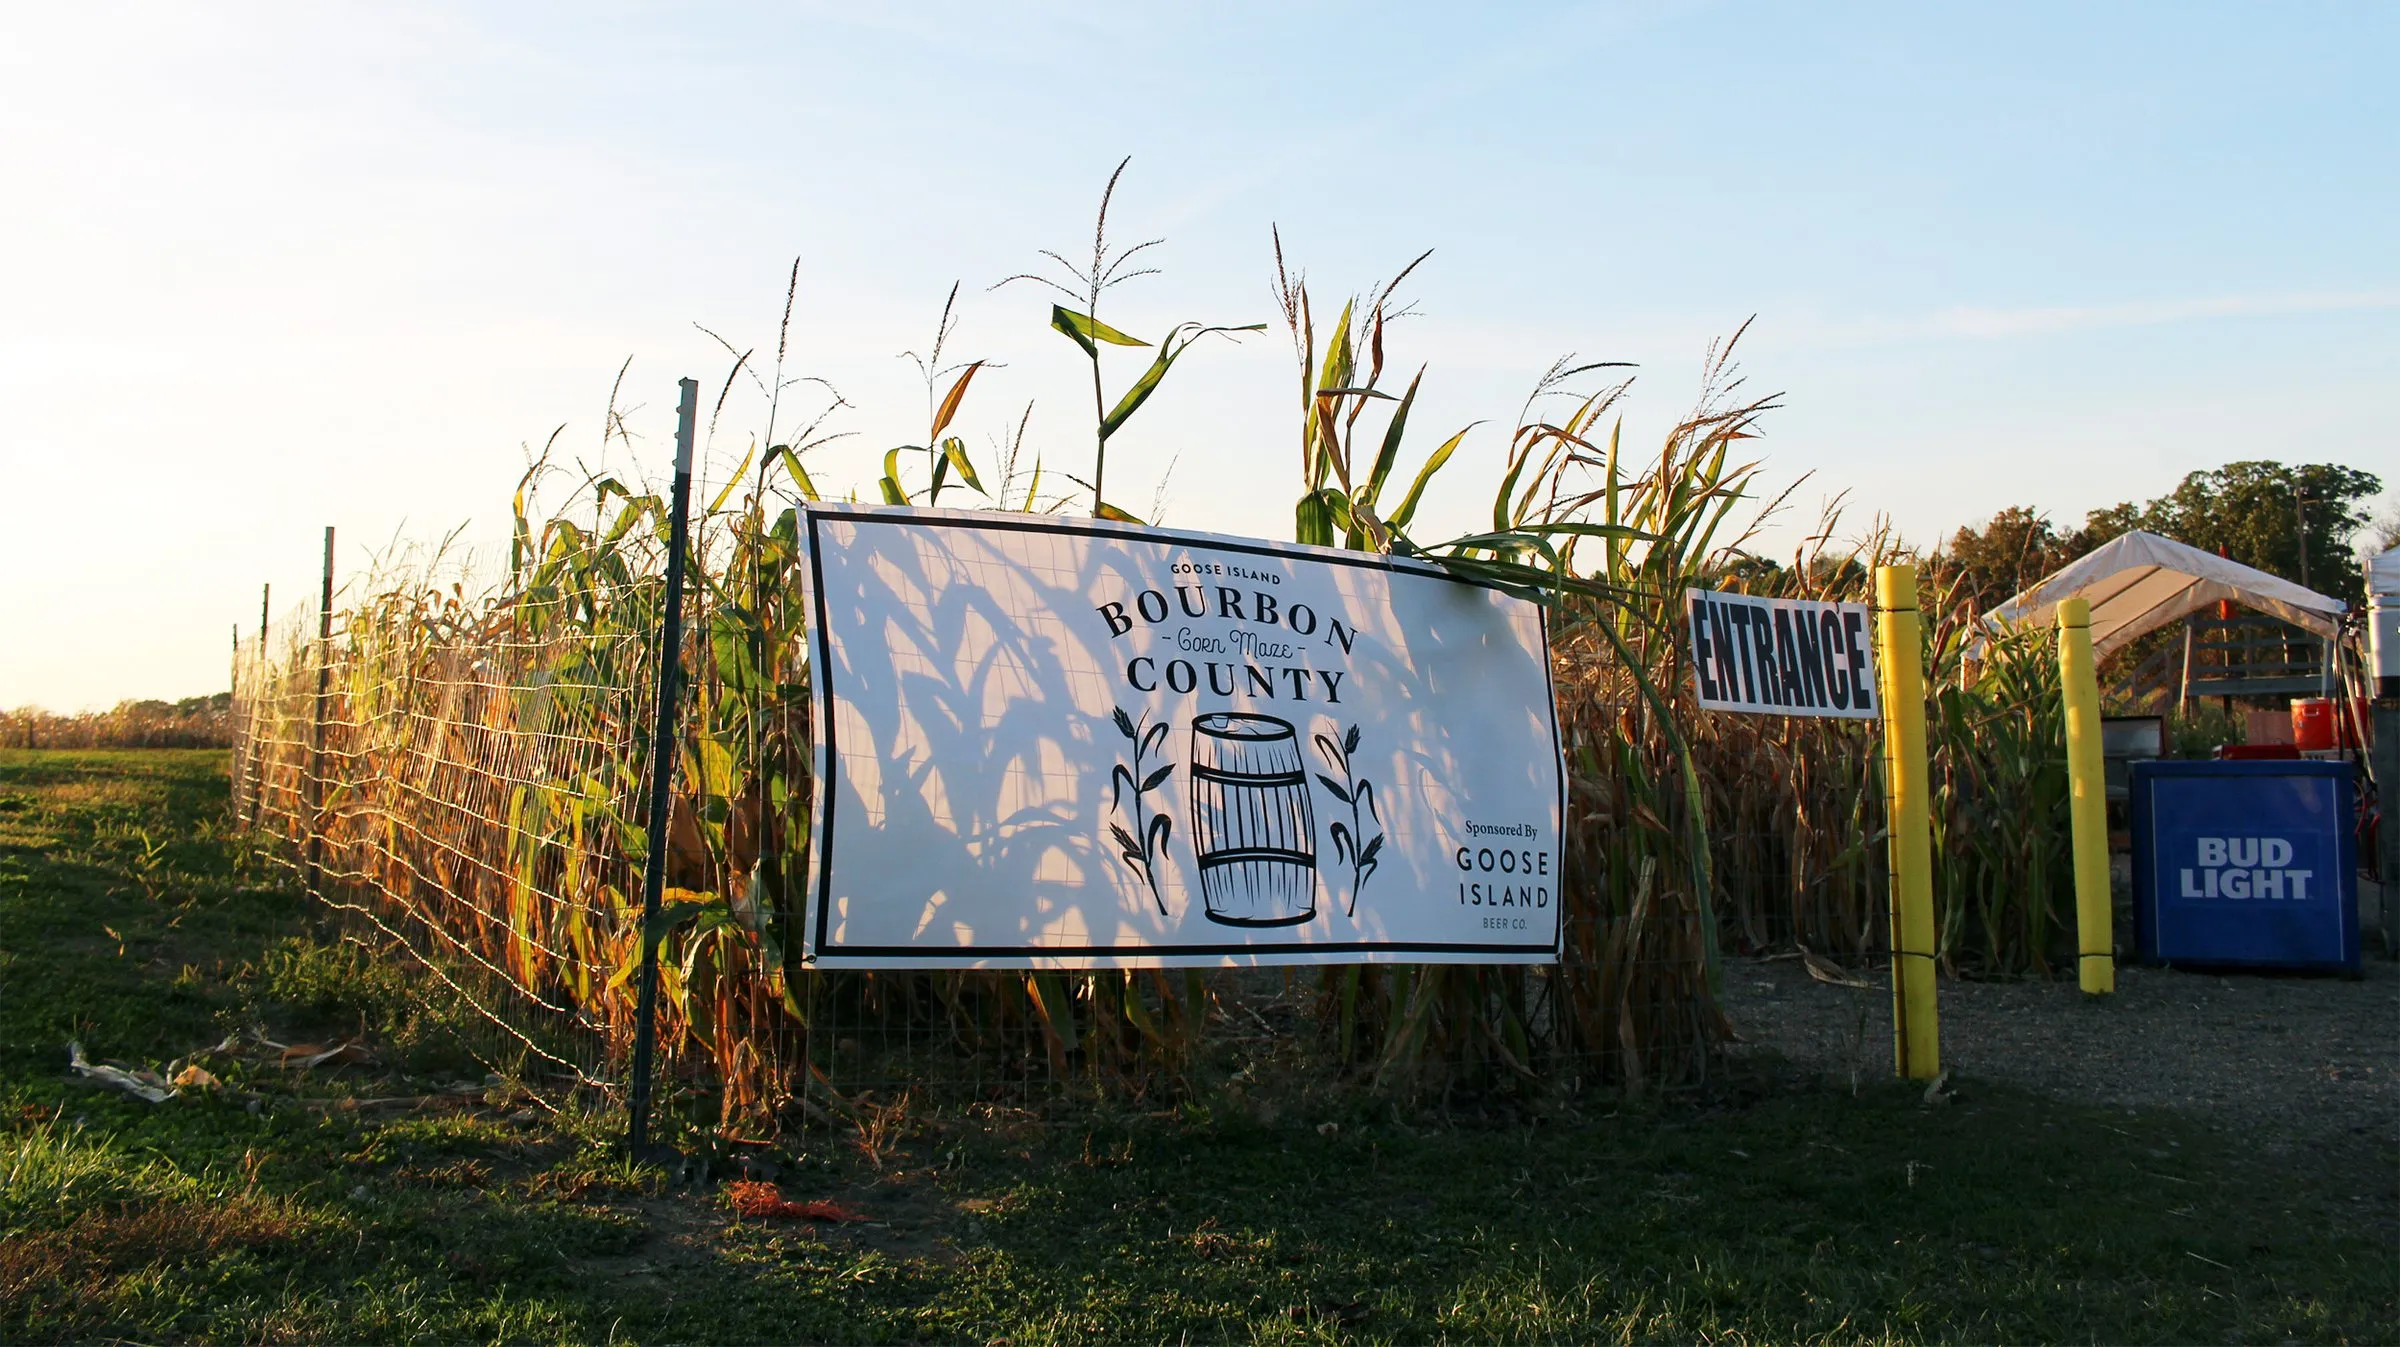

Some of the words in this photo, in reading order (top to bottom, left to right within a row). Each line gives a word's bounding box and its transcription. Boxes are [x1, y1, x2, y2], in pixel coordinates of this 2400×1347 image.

[1171, 563, 1222, 575] GOOSE
[1227, 566, 1281, 585] ISLAND
[1096, 585, 1358, 655] BOURBON
[1692, 599, 1871, 710] ENTRANCE
[1127, 656, 1344, 703] COUNTY
[1465, 820, 1522, 837] Sponsored
[1524, 824, 1538, 841] By
[1456, 846, 1548, 875] GOOSE
[2197, 837, 2293, 868] BUD
[1459, 883, 1548, 908] ISLAND
[2180, 868, 2313, 900] LIGHT
[1483, 917, 1508, 929] BEER
[1512, 918, 1528, 930] CO.
